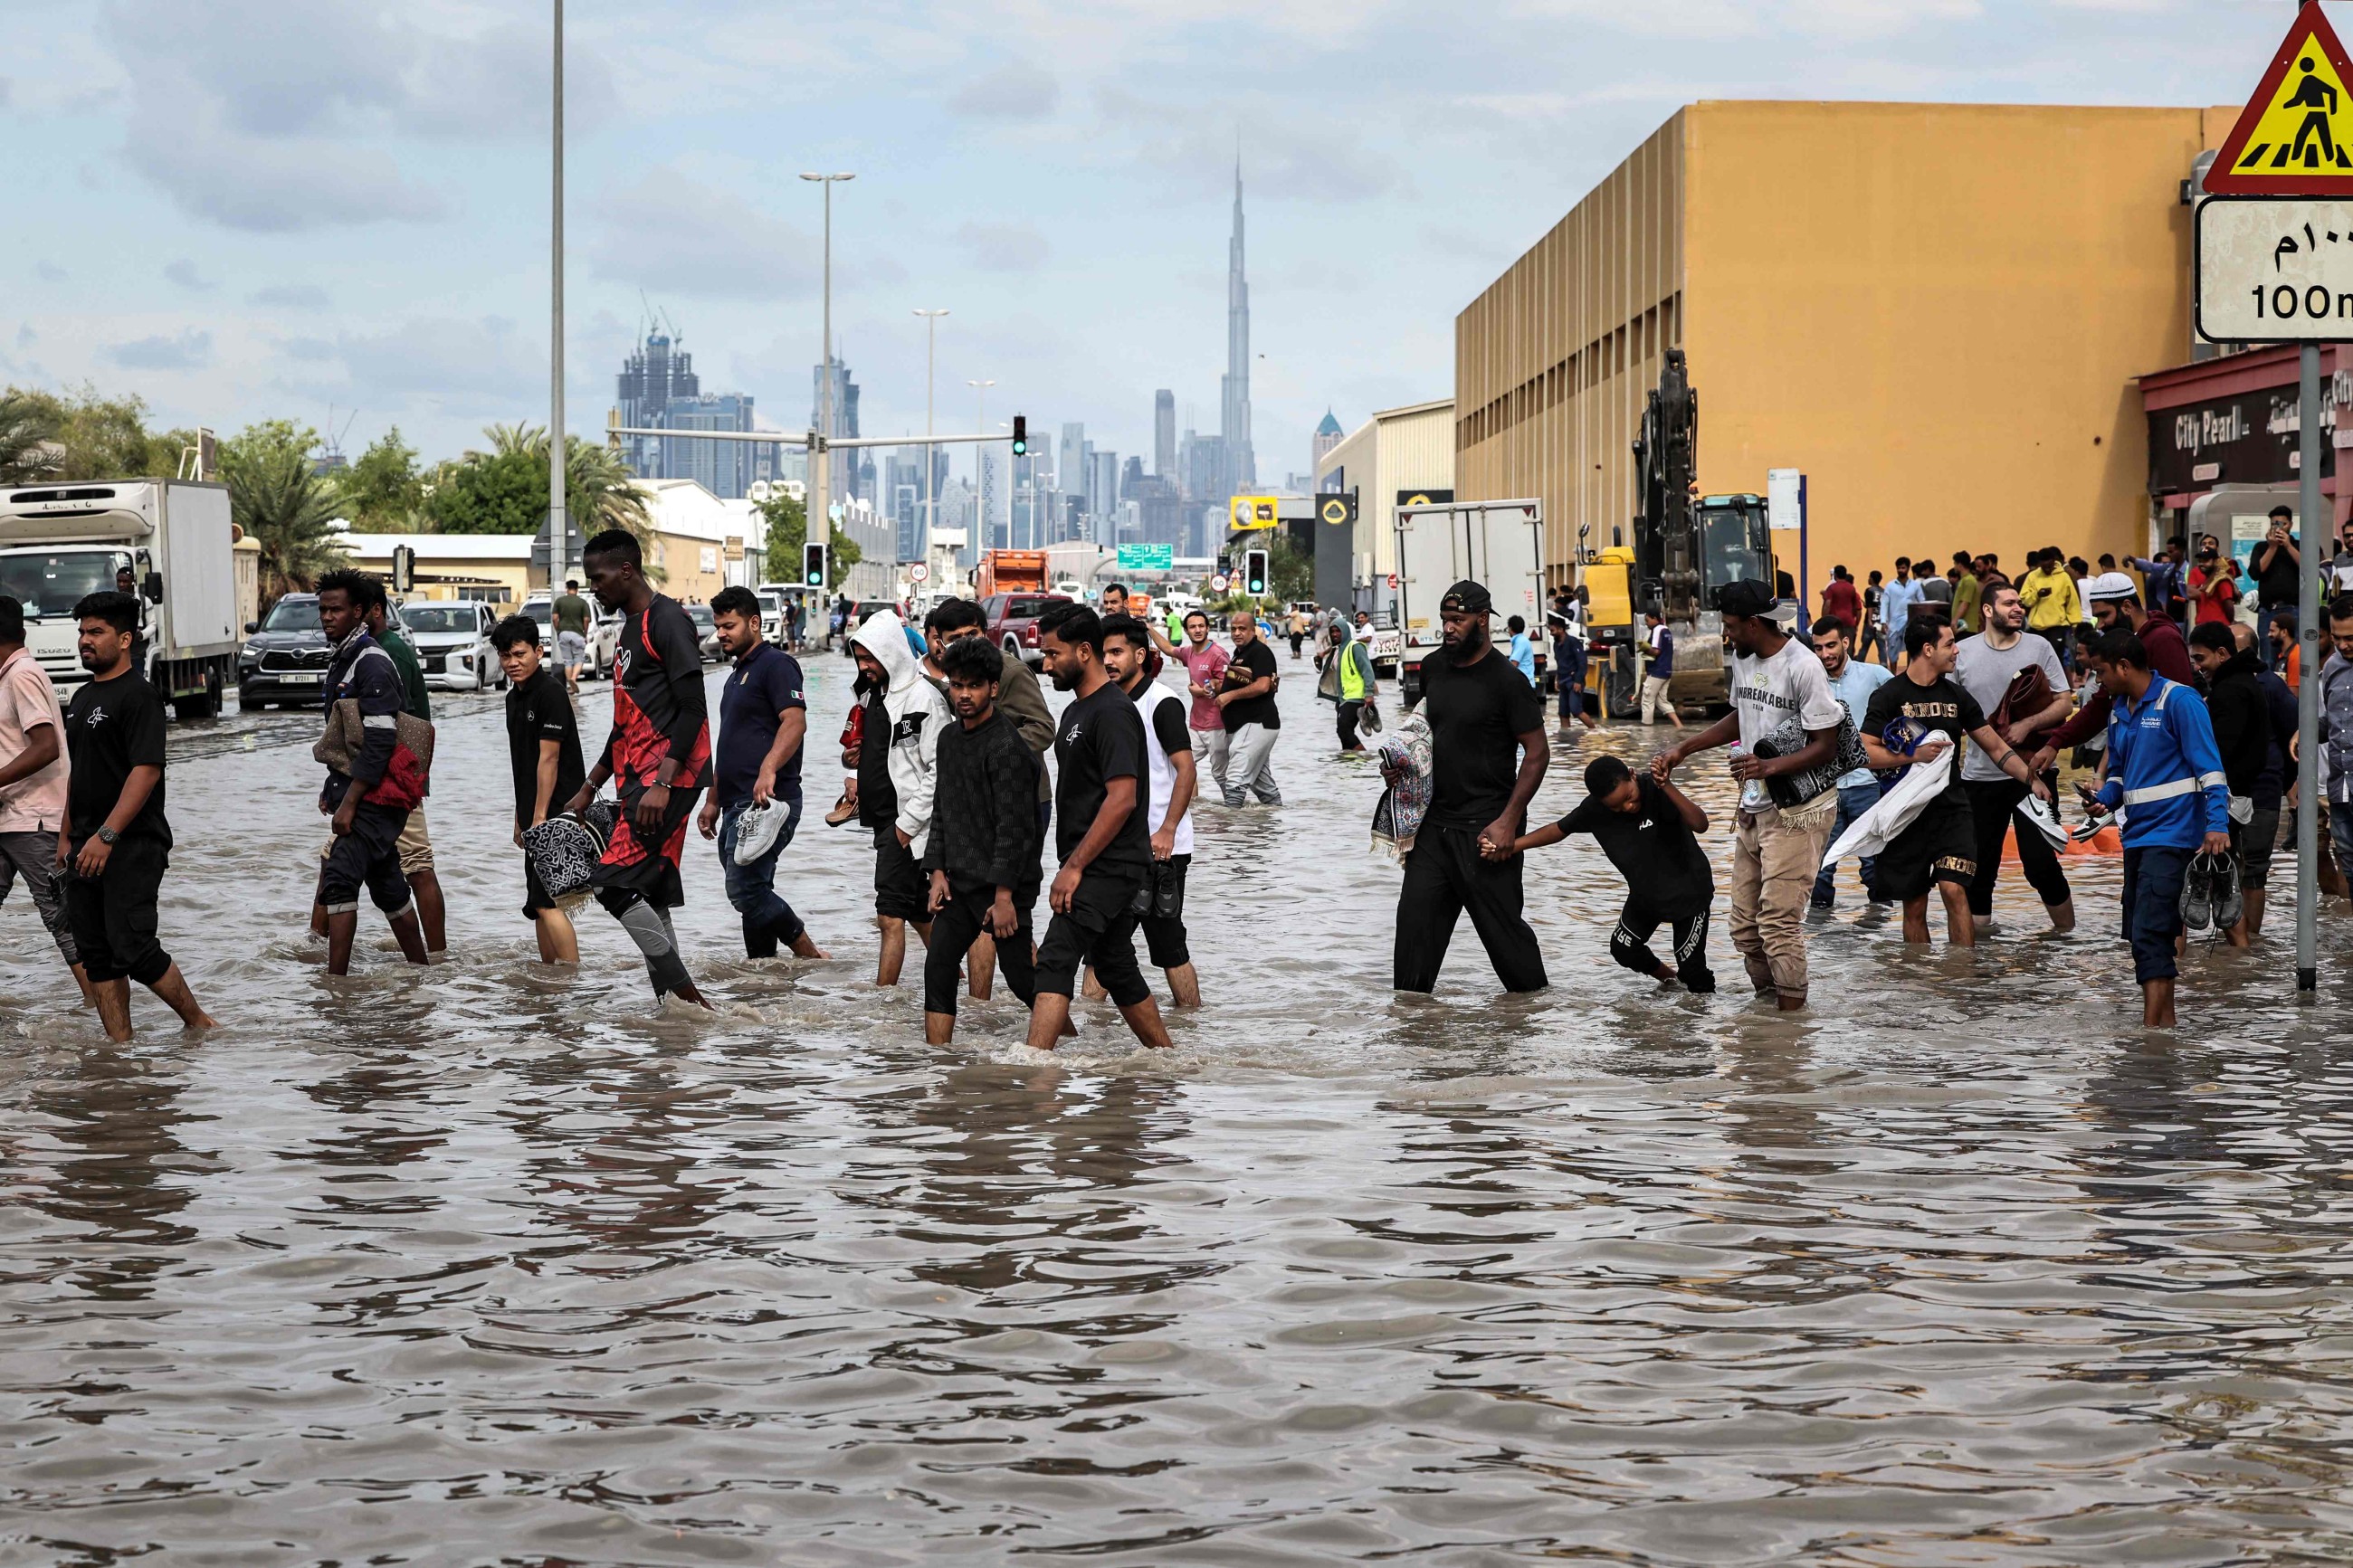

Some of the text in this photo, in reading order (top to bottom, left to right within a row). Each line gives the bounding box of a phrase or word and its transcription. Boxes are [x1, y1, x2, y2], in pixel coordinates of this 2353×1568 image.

[2176, 413, 2200, 457] City
[2203, 405, 2241, 446] Pearl
[900, 719, 913, 735] R
